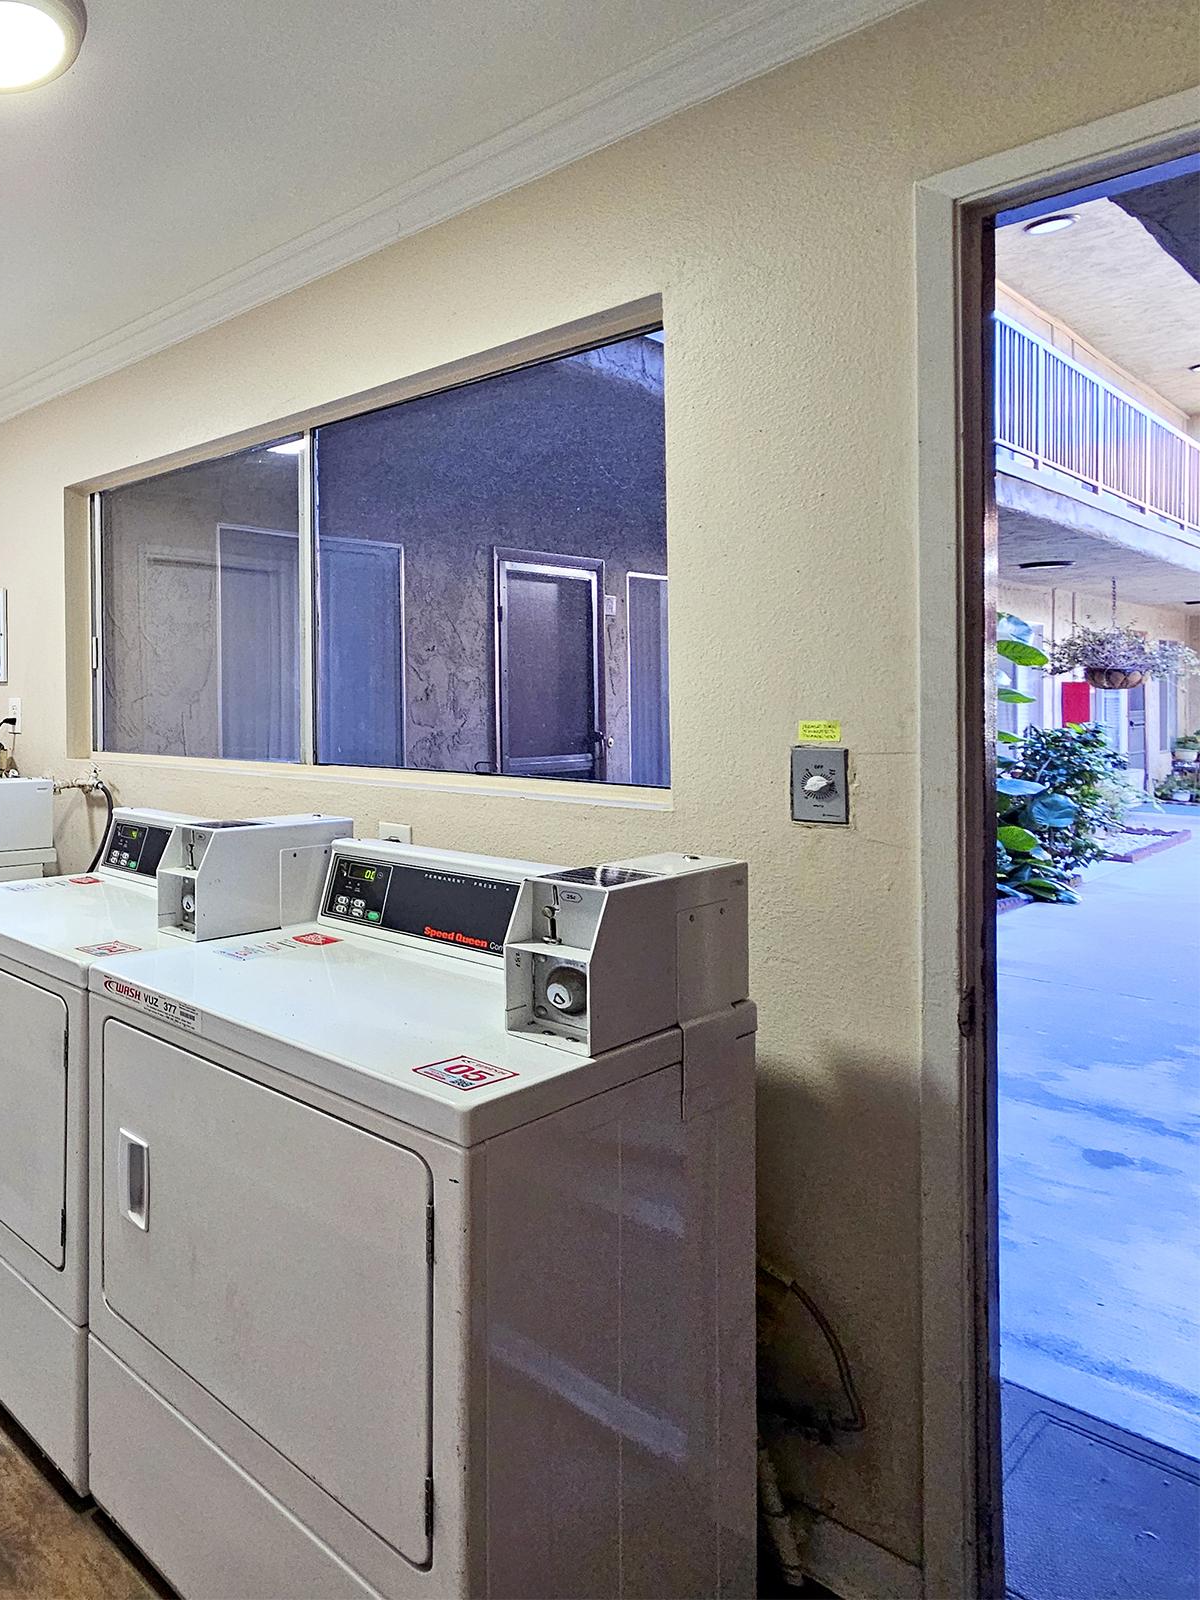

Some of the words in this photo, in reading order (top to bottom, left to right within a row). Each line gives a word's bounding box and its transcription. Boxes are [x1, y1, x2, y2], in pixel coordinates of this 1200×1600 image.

[424, 874, 465, 884] PERMANENT
[424, 926, 455, 940] Speed
[456, 933, 488, 947] Queen
[115, 984, 141, 1001] WASH
[144, 993, 159, 1008] VUZ
[163, 1002, 177, 1014] 377
[444, 1064, 495, 1081] 05
